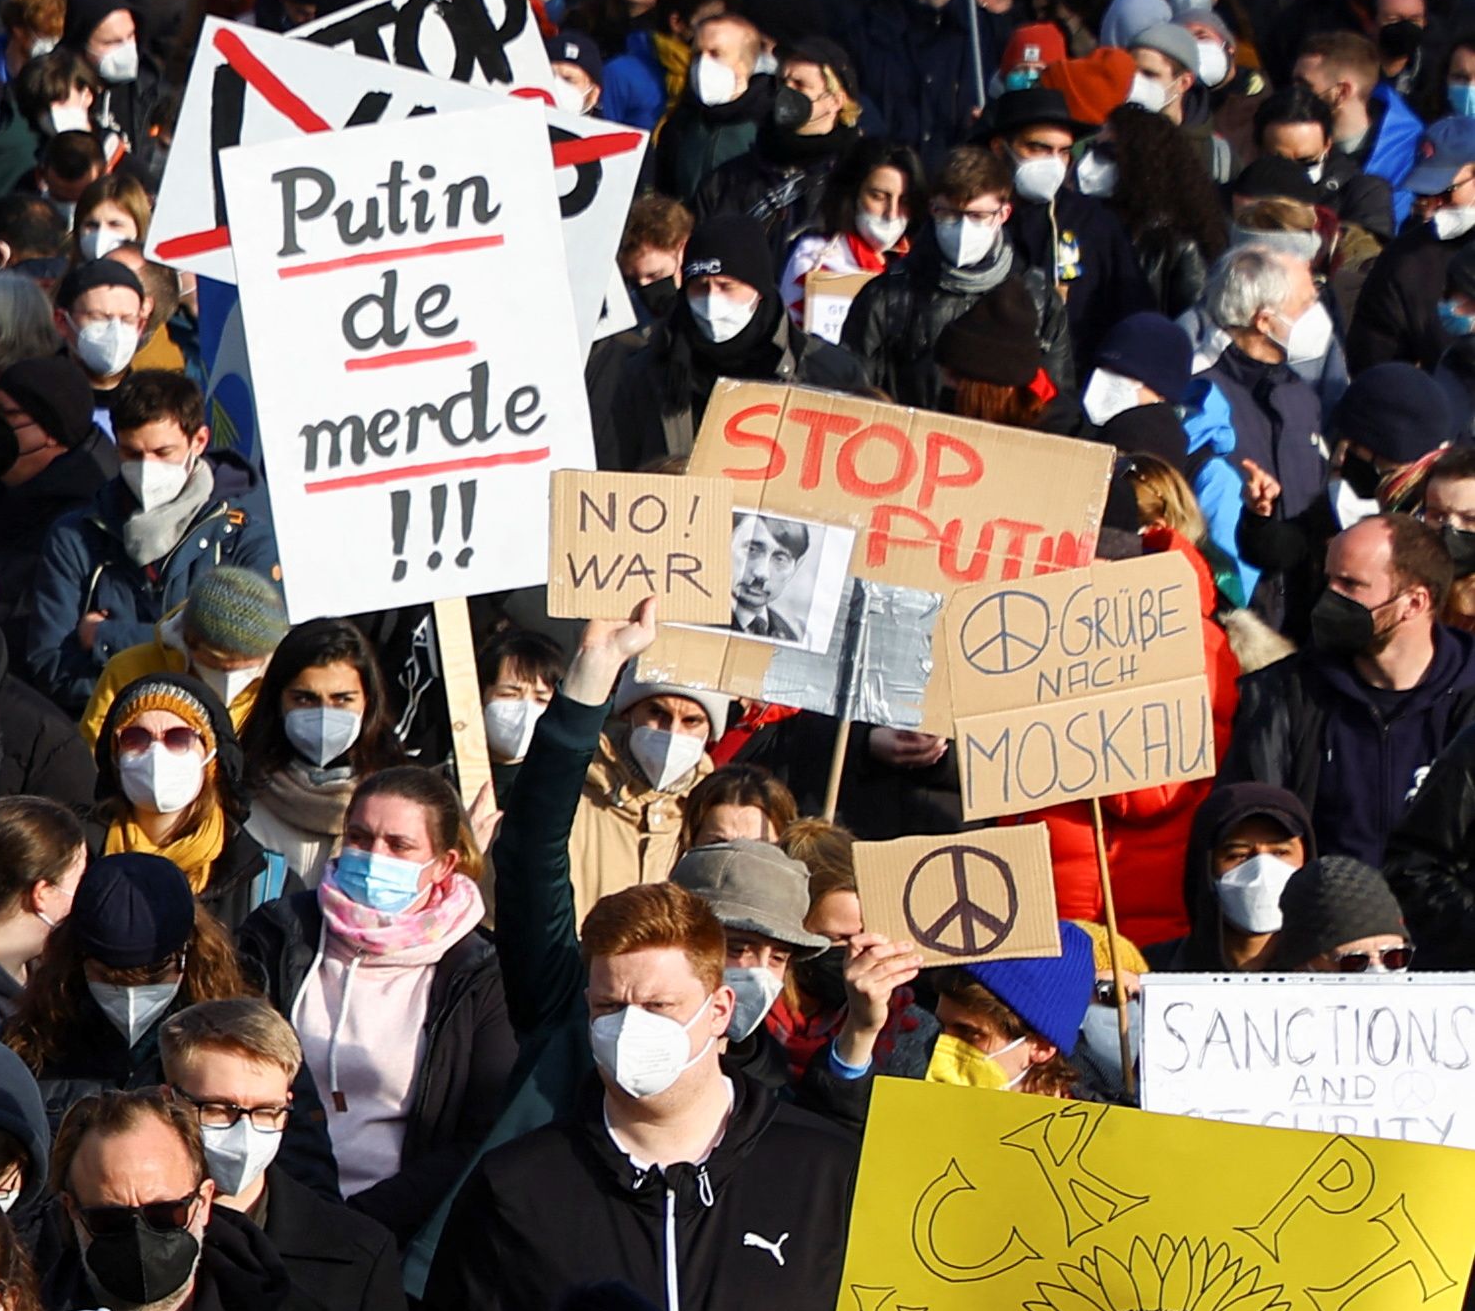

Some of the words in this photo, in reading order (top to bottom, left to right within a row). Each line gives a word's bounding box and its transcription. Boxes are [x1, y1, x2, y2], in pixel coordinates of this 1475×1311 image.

[271, 159, 502, 258] Putin
[341, 269, 460, 353] de
[298, 361, 548, 473] merde
[722, 403, 984, 509] STOP
[388, 479, 477, 583] !!!
[866, 503, 1101, 583] PUTIN
[566, 550, 714, 598] WAR
[1036, 655, 1140, 702] NACH
[965, 696, 1213, 812] MOSKAU
[1163, 1000, 1475, 1074] SANCTIONS
[1288, 1082, 1377, 1114] AND
